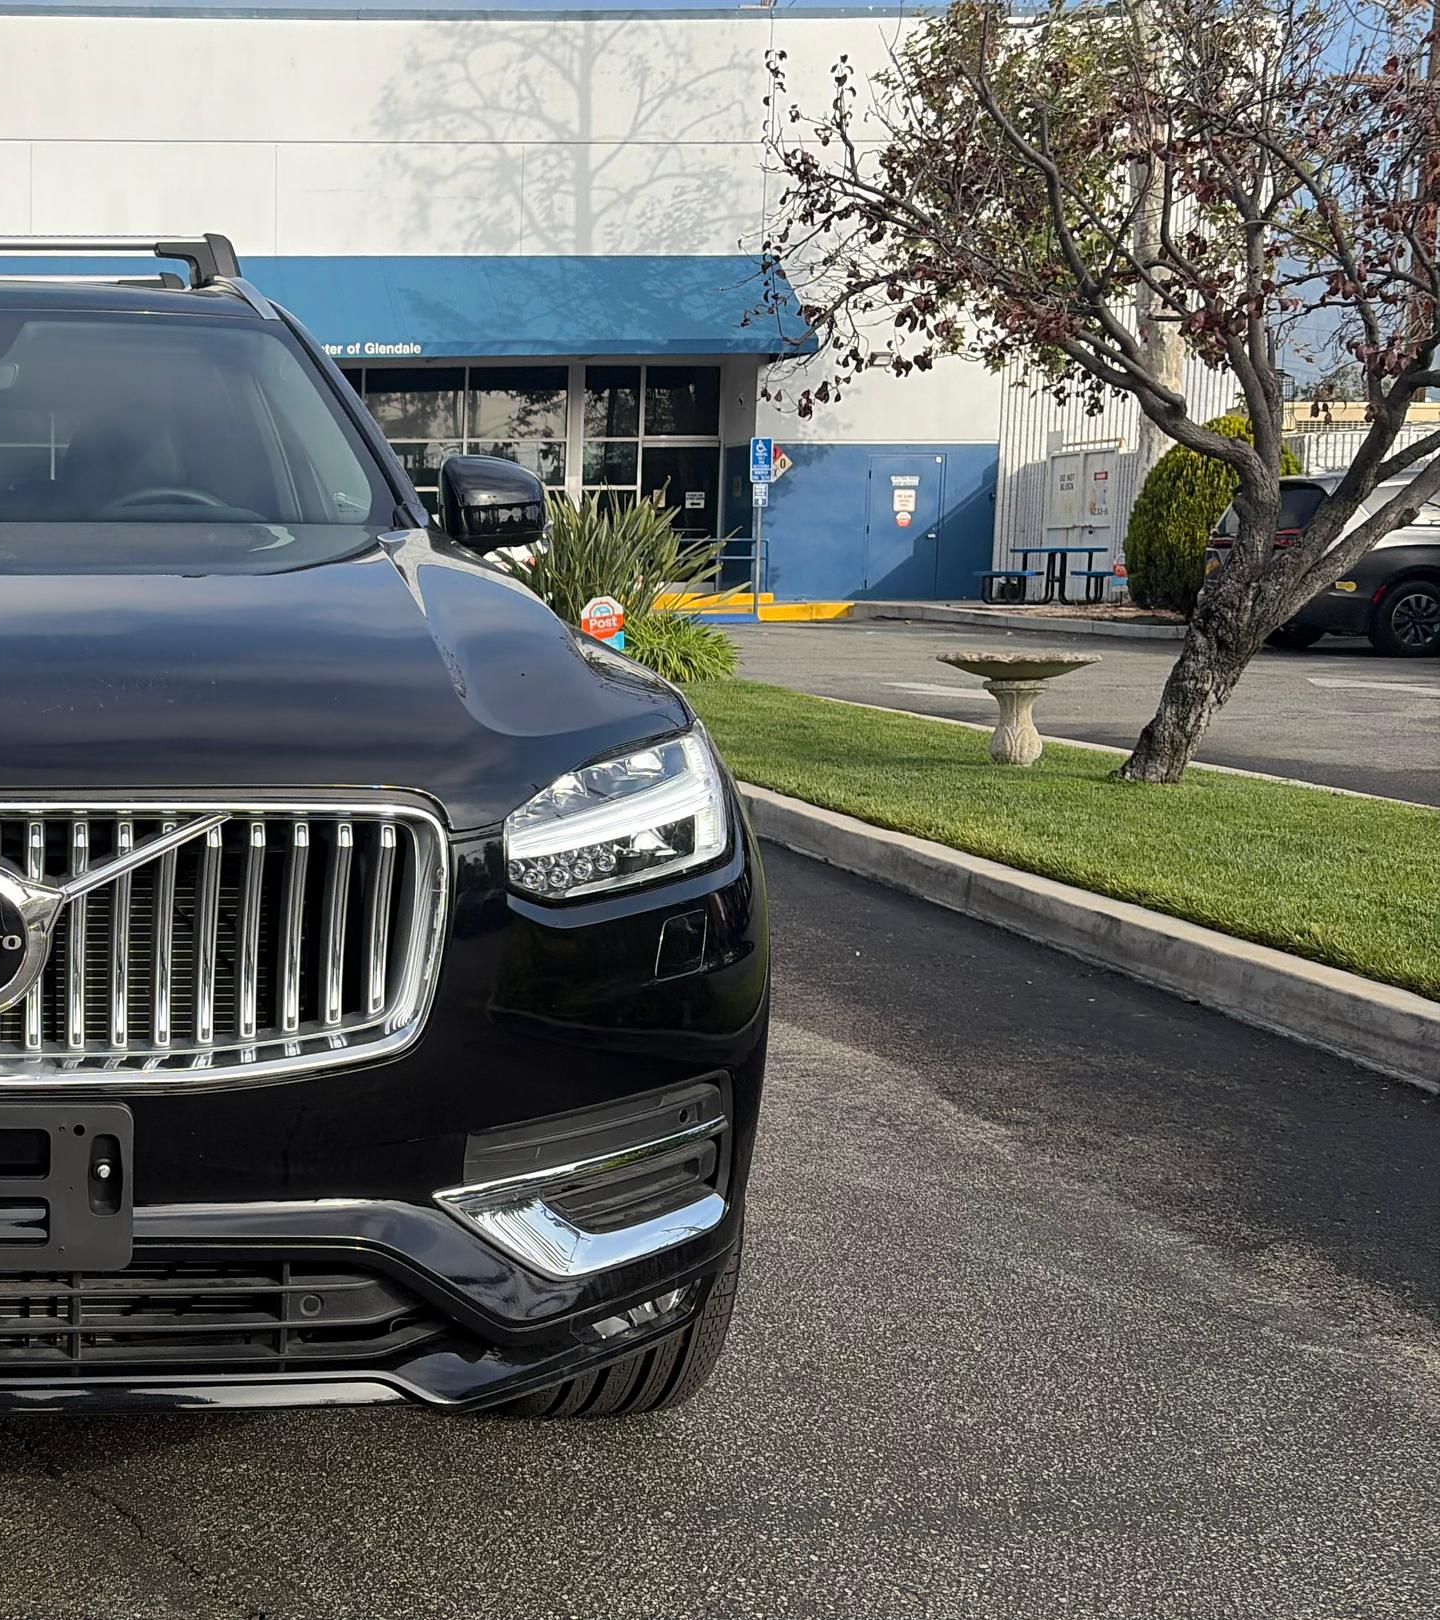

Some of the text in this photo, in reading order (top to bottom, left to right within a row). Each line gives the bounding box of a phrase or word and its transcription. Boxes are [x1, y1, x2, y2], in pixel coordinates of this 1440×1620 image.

[322, 342, 422, 355] ter of Glendale
[589, 616, 617, 629] Post
